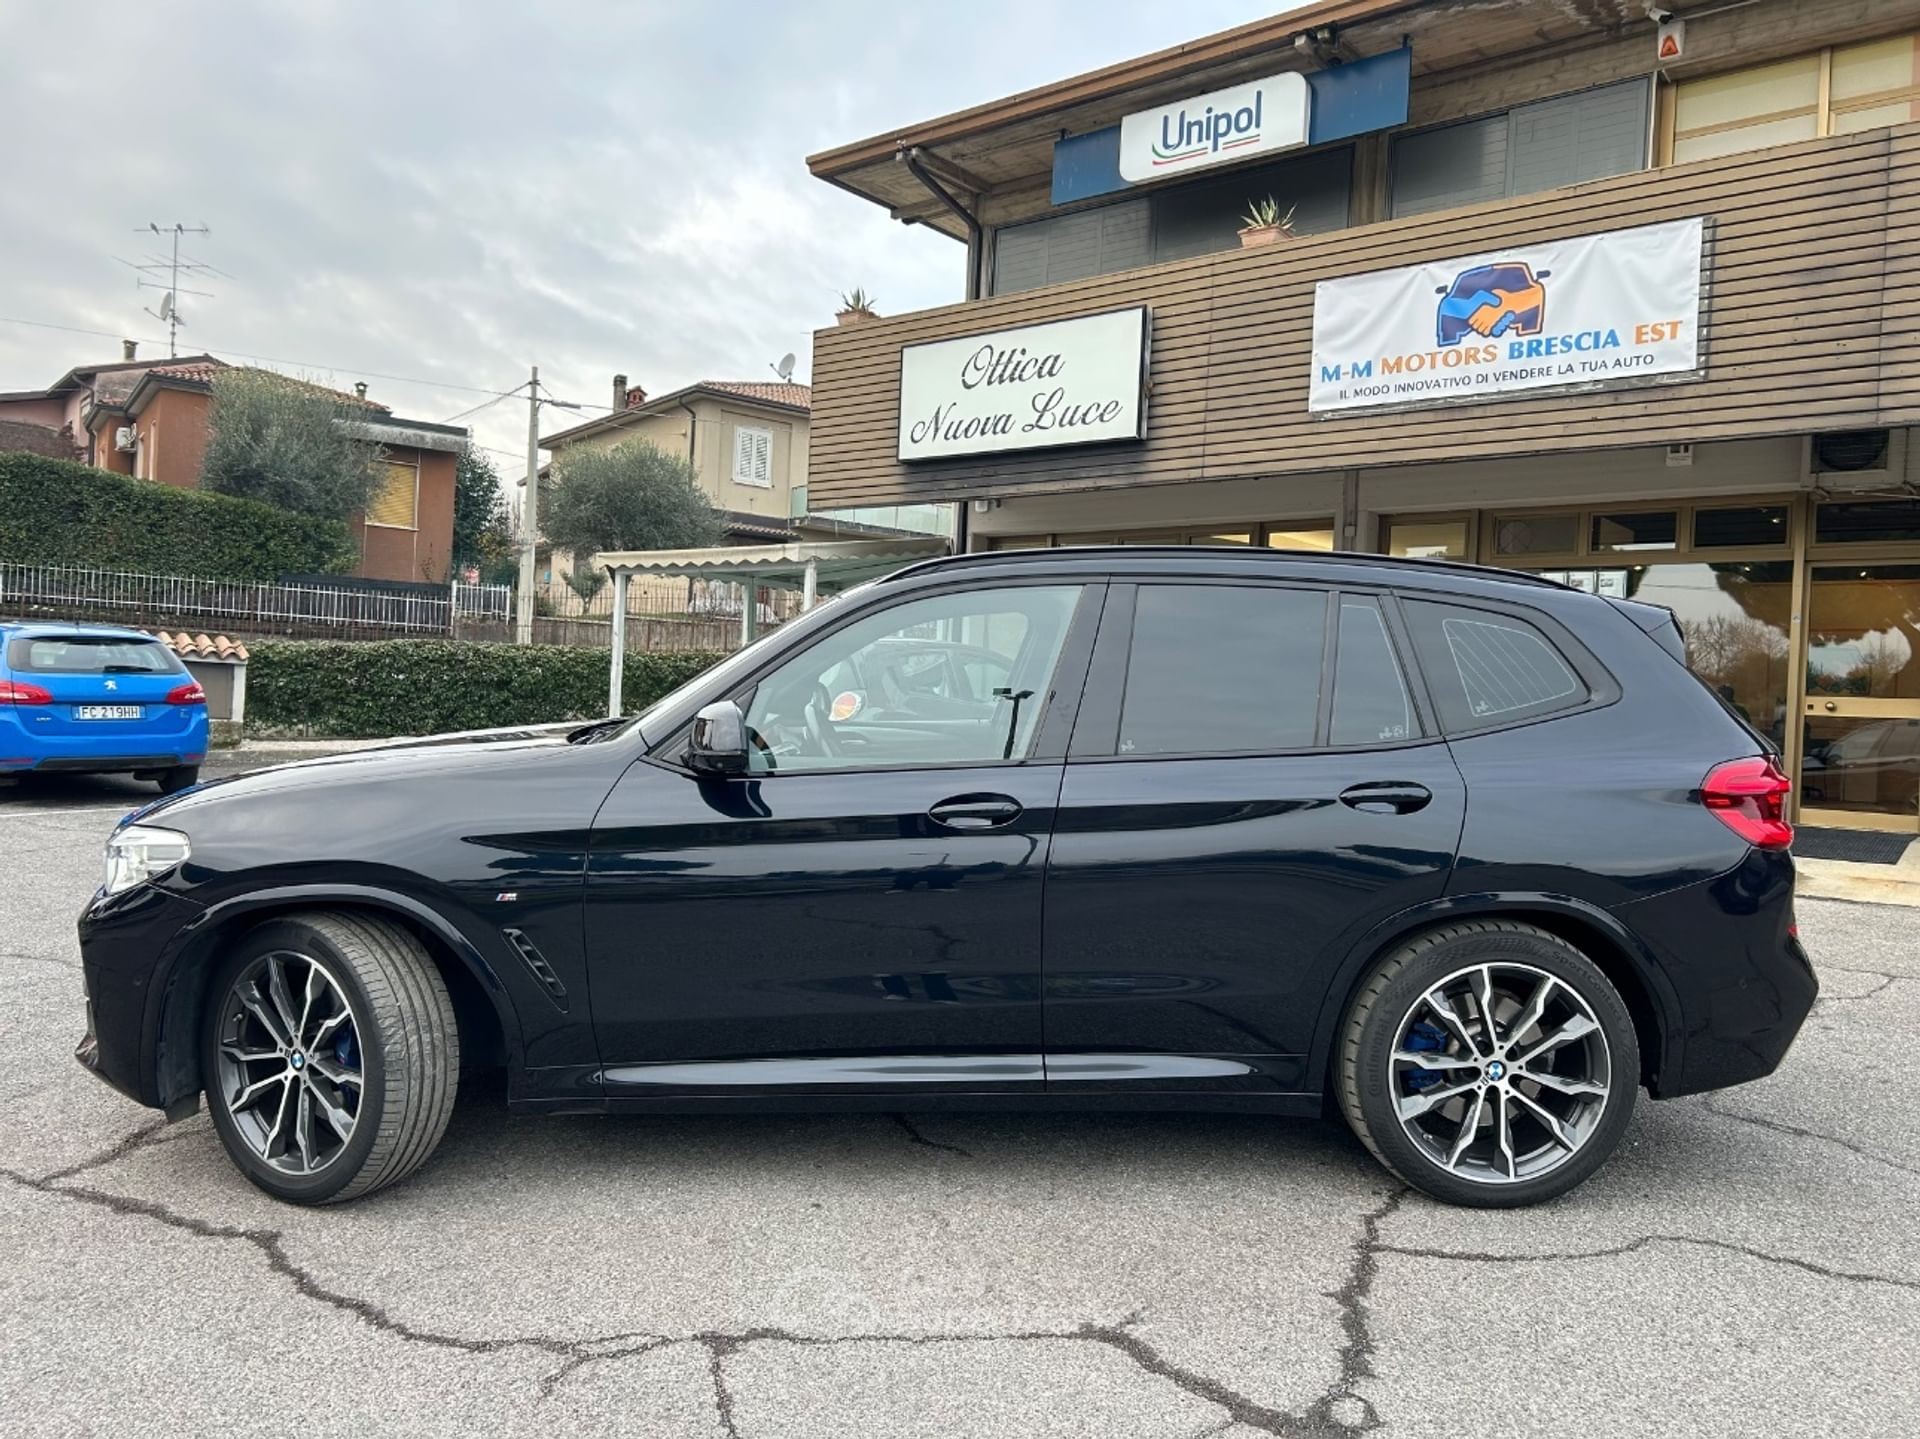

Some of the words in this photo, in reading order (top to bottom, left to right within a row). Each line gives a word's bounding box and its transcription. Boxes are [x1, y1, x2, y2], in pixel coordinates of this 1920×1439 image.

[1162, 90, 1263, 152] Unipol
[961, 344, 1066, 390] Ottica
[1321, 360, 1373, 383] M-M
[1381, 344, 1498, 375] MOTORS
[1508, 328, 1621, 360] BRESCIA
[1634, 320, 1684, 345] EST
[1339, 389, 1350, 400] IL
[1353, 384, 1390, 398] MODO
[1394, 377, 1471, 393] INNOVATIVO
[1475, 373, 1489, 384] DI
[1493, 366, 1552, 382] VENDERE
[1557, 363, 1575, 375] LA
[1579, 359, 1609, 373] TUA
[1612, 354, 1655, 370] AUTO
[911, 402, 1016, 444] Nuova
[1021, 387, 1123, 433] Luce
[81, 706, 97, 719] FC
[101, 706, 139, 719] 219HH
